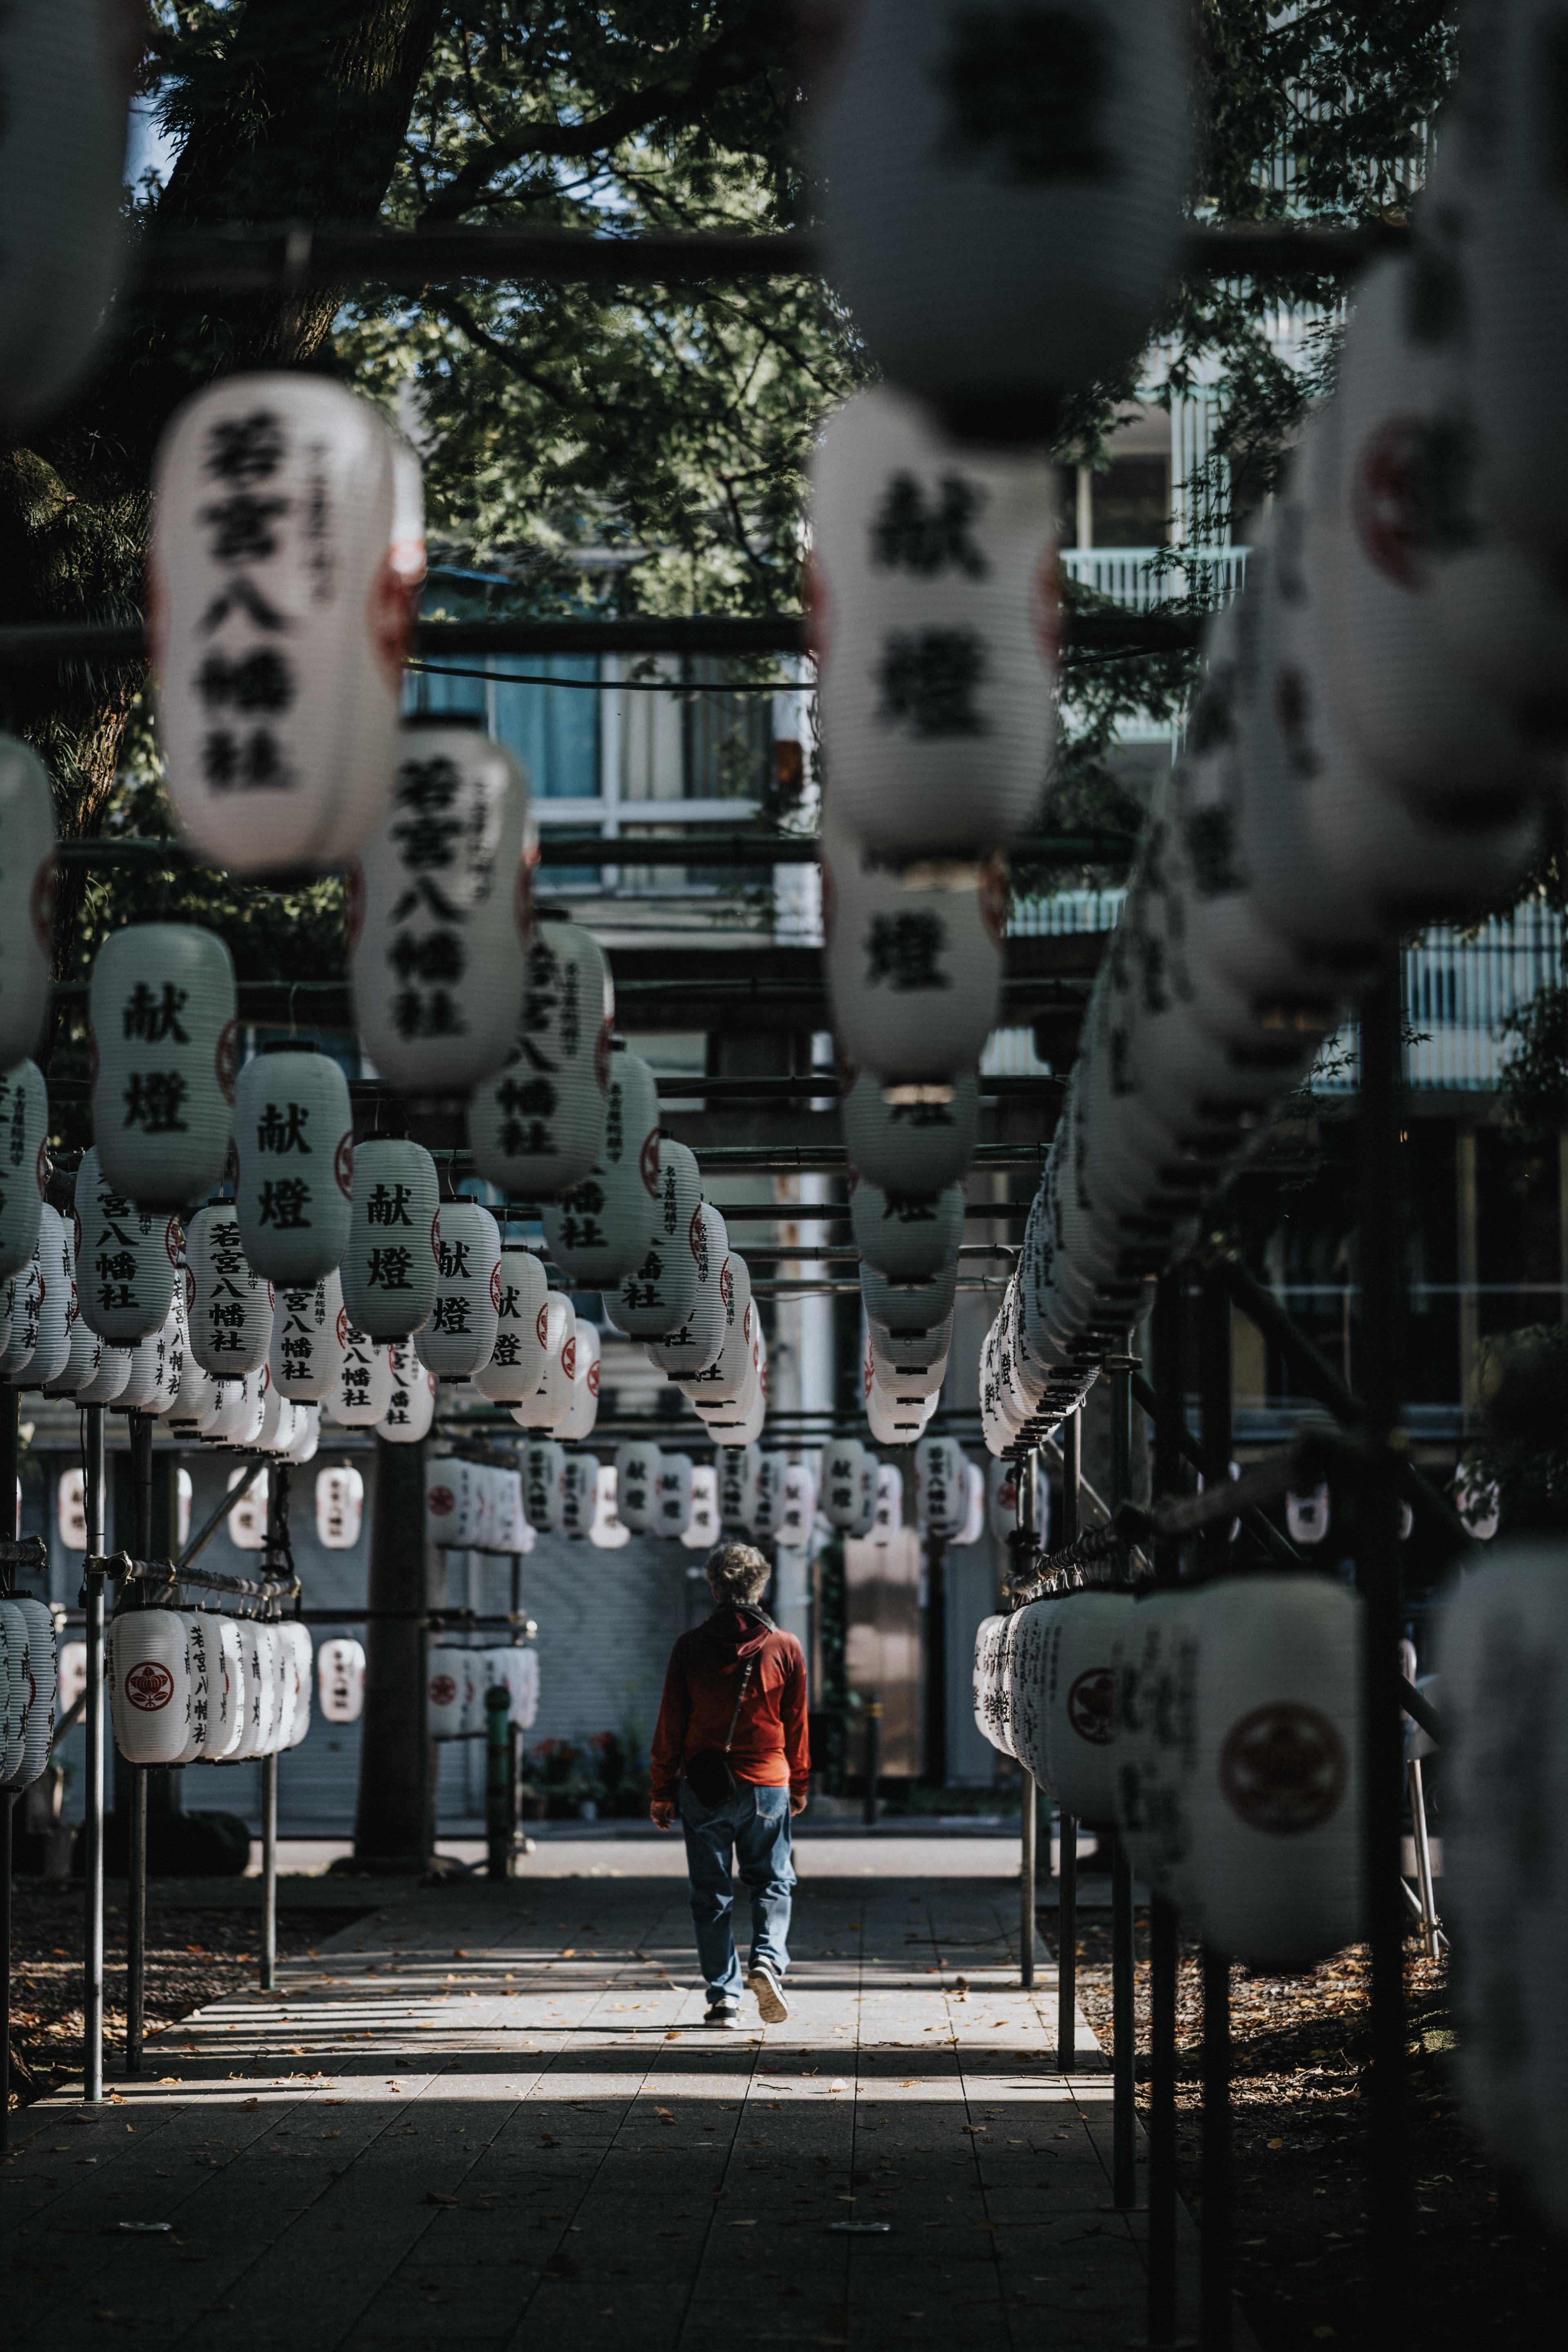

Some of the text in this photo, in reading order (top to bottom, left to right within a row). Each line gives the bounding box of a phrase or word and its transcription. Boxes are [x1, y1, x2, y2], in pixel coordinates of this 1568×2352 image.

[122, 983, 190, 1132] 献燈
[257, 1102, 312, 1228] 献燈
[663, 1166, 677, 1235] 名古屋総鎮守
[95, 1173, 140, 1311] 宮八幡社
[208, 1221, 248, 1352] 若宮八幡社
[367, 1184, 413, 1290] 献燈
[432, 1241, 473, 1334] 献燈
